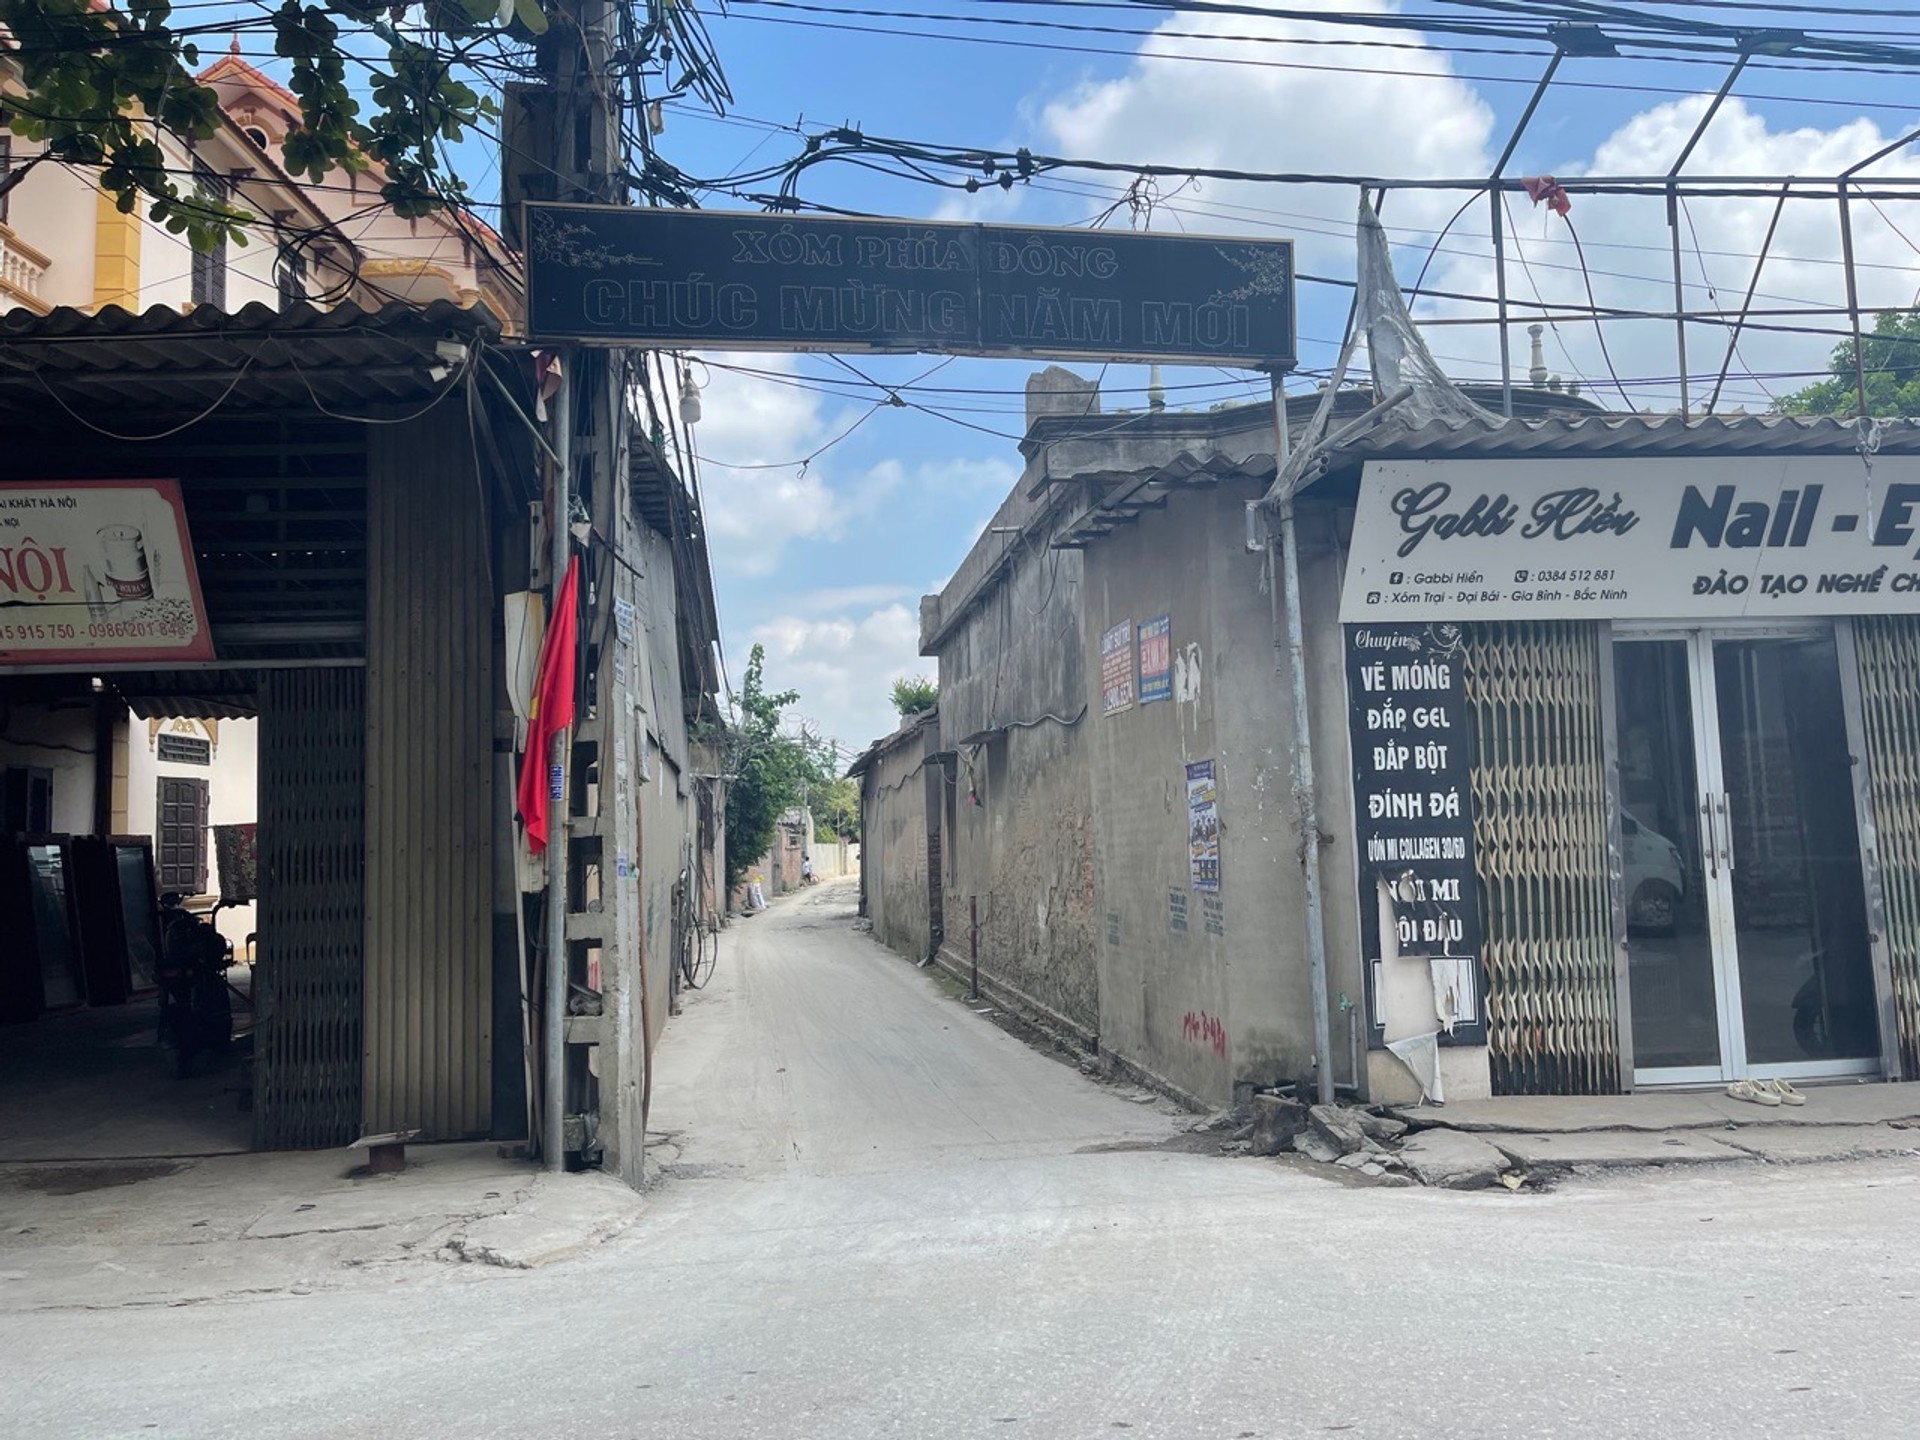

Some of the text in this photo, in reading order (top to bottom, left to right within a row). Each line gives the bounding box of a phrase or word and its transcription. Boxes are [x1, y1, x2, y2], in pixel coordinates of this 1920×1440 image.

[732, 224, 1119, 279] XÓM PHÍA ĐÔNG
[583, 273, 1250, 347] CHÚC MỪNG NĂM MỚI
[9, 496, 37, 508] KHÁT
[40, 496, 56, 508] HÀ
[57, 495, 77, 510] NỘI
[1391, 481, 1519, 557] Gabbi
[1670, 484, 1824, 549] Nail
[1872, 483, 1920, 560] E
[0, 536, 76, 601] NỘI
[1414, 572, 1454, 584] Gabbi
[1537, 570, 1566, 582] 0384
[1569, 570, 1591, 581] 512
[1594, 569, 1615, 581] 881
[1692, 568, 1749, 595] ĐÀO
[1760, 574, 1808, 598] TẠO
[1816, 564, 1889, 594] NGHỀ
[1391, 591, 1420, 603] Xóm
[1424, 591, 1444, 605] Trại
[1456, 590, 1477, 605] Đại
[1480, 590, 1500, 602] Bái
[1511, 590, 1533, 602] Gia
[1536, 588, 1561, 602] Bình
[1573, 588, 1596, 601] Bắc
[1600, 589, 1628, 601] Ninh
[17, 624, 45, 640] 915
[48, 623, 75, 639] 750
[89, 623, 124, 638] 0986
[1355, 630, 1408, 651] Chuyên
[1361, 659, 1450, 691] VẼ MÓNG
[1367, 697, 1450, 730] ĐẮP GEL
[1373, 738, 1448, 775] ĐẮP BỘT
[1368, 786, 1460, 820] ĐÍNH ĐÁ
[1387, 838, 1398, 860] MI
[1399, 837, 1440, 860] COLLAGEN
[1430, 879, 1460, 901] MI
[1395, 915, 1418, 947] ỘI
